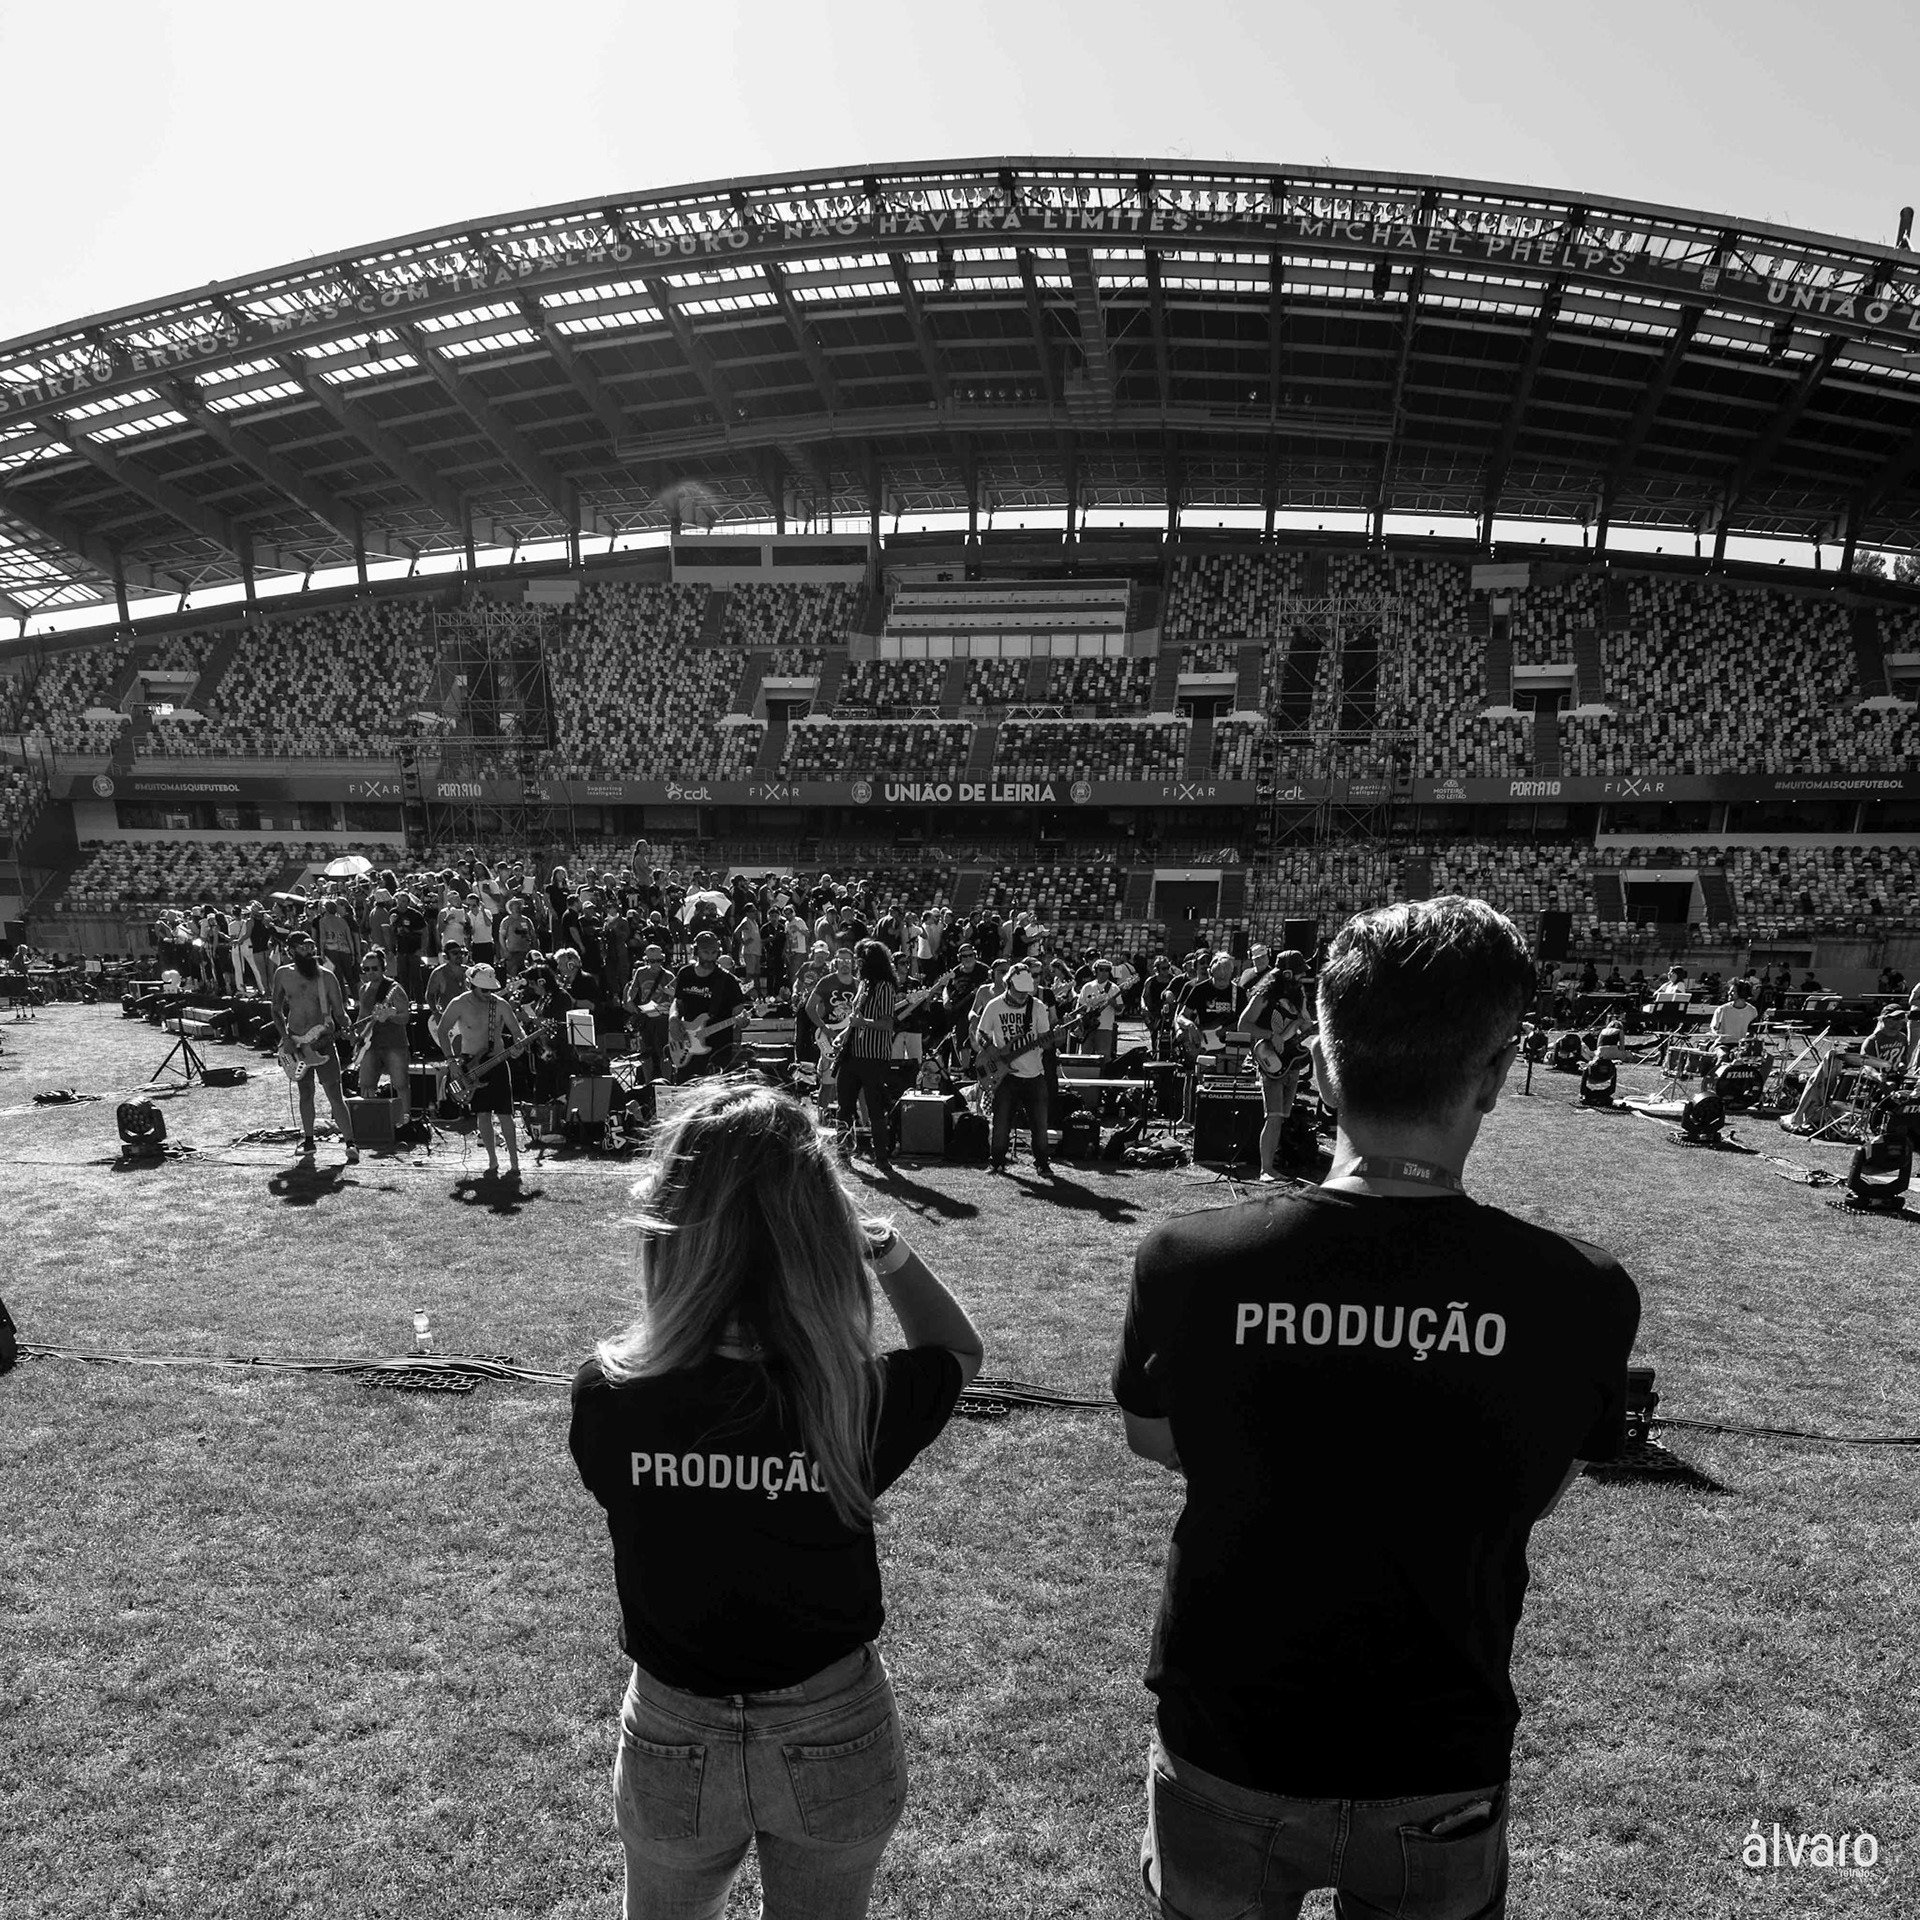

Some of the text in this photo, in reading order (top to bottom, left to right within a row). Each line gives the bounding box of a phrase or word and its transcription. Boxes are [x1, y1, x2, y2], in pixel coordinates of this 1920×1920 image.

[358, 281, 430, 313] COM
[1299, 217, 1463, 254] MICHAEL
[1486, 236, 1628, 275] PHELPS
[134, 783, 240, 792] #MUITOMAISQUEFUTEBOL
[349, 780, 401, 798] FIXAR
[683, 787, 712, 800] cdt
[749, 783, 800, 801] FIXAR
[884, 783, 953, 802] UNIÃO
[958, 784, 986, 802] DE
[991, 784, 1056, 802] LEIRIA
[1162, 783, 1216, 801] FIXAR
[1604, 778, 1665, 796] FIXAR
[1774, 780, 1904, 790] #MUITOMAISQUEFUTEBOL
[1235, 1301, 1507, 1362] PRODUÇÃO
